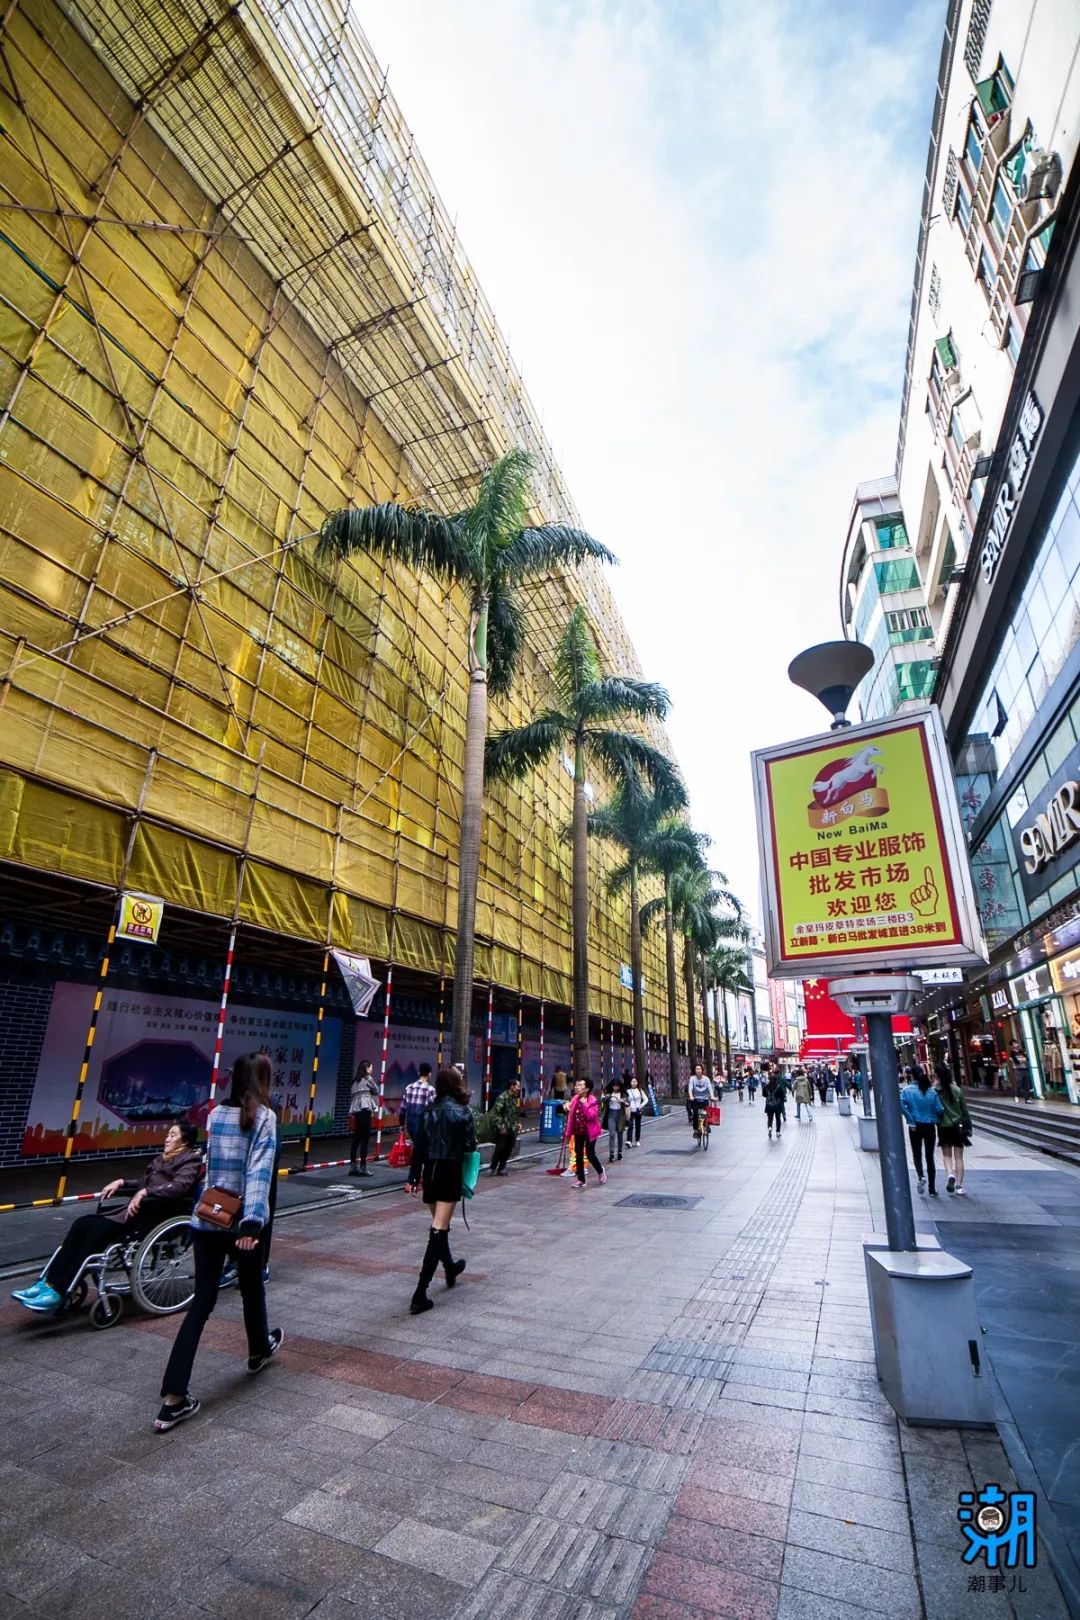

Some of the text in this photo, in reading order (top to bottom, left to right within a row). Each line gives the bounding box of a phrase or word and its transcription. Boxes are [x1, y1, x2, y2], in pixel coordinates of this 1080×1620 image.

[821, 792, 874, 824] 新白马
[817, 821, 888, 840] New BaiMa
[789, 831, 926, 871] 中国专业服饰
[808, 862, 910, 896] 批发市场
[826, 892, 898, 917] 欢迎您
